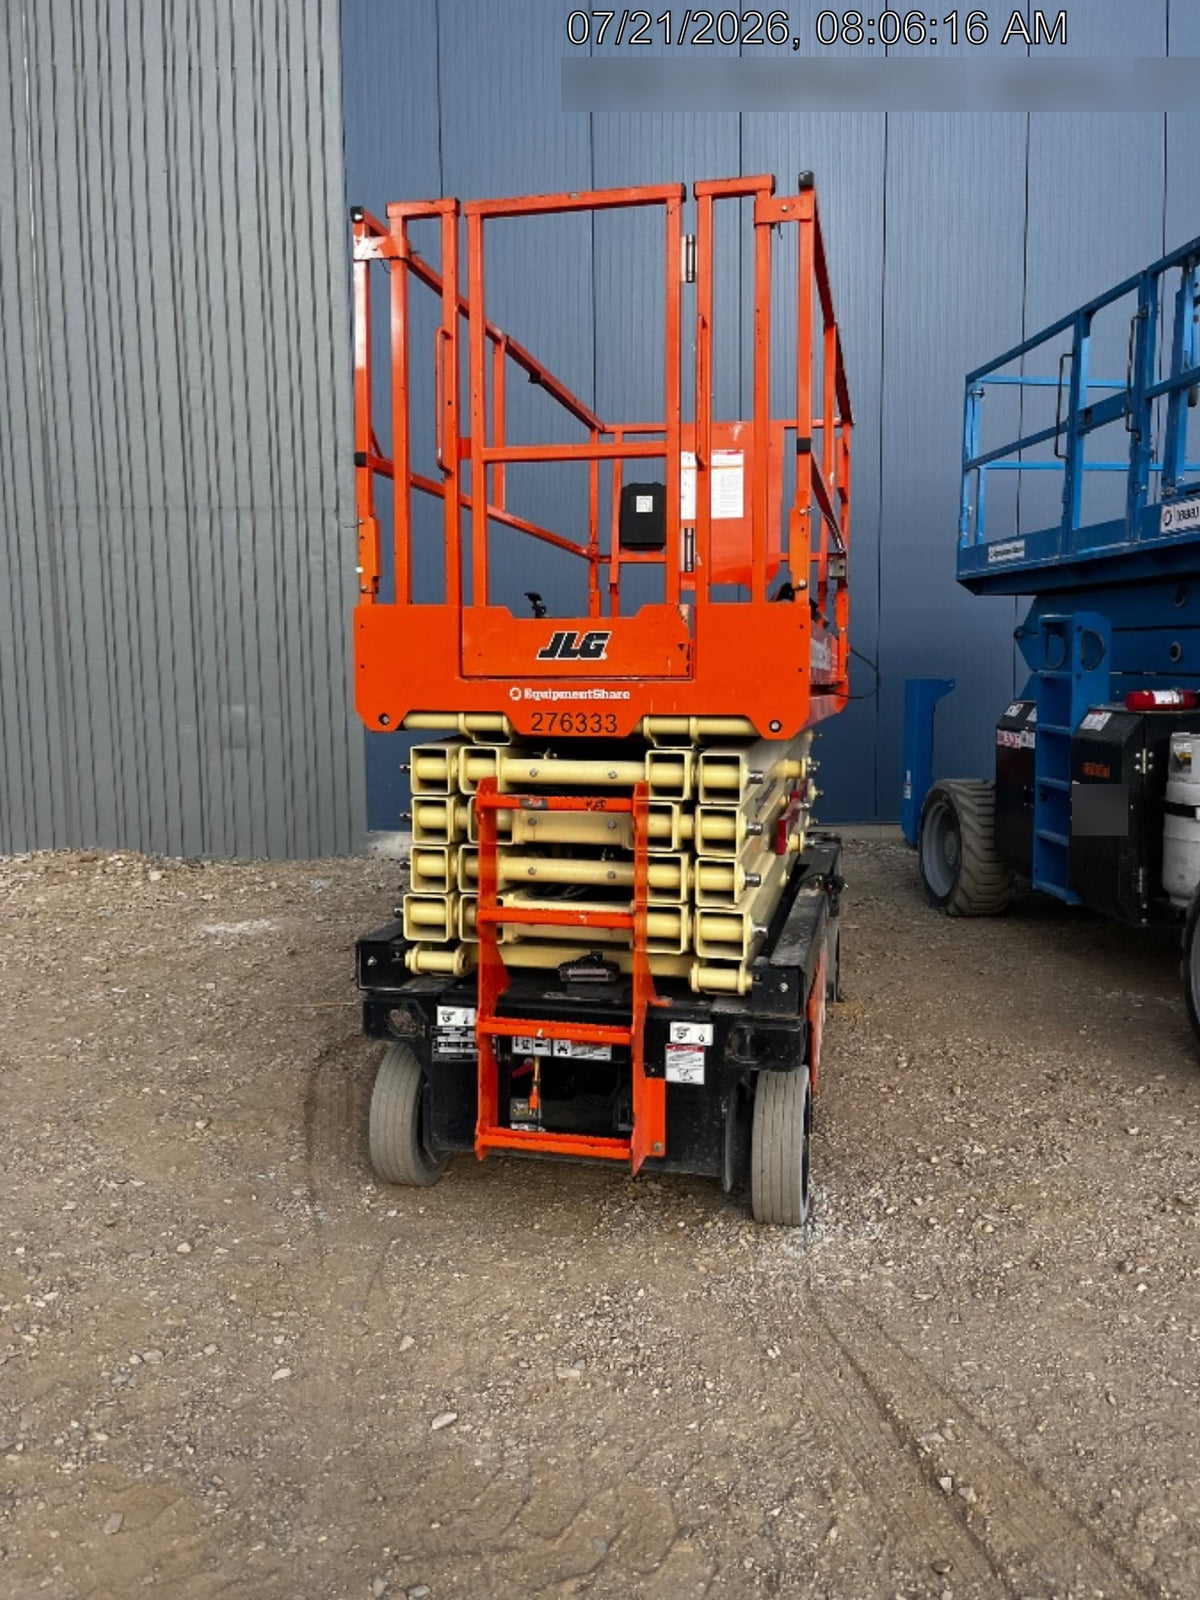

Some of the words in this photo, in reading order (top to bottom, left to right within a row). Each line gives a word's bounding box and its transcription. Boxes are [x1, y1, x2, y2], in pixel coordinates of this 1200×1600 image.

[535, 631, 612, 660] JLG
[524, 688, 630, 700] EquipmentShare
[530, 712, 618, 733] 276333
